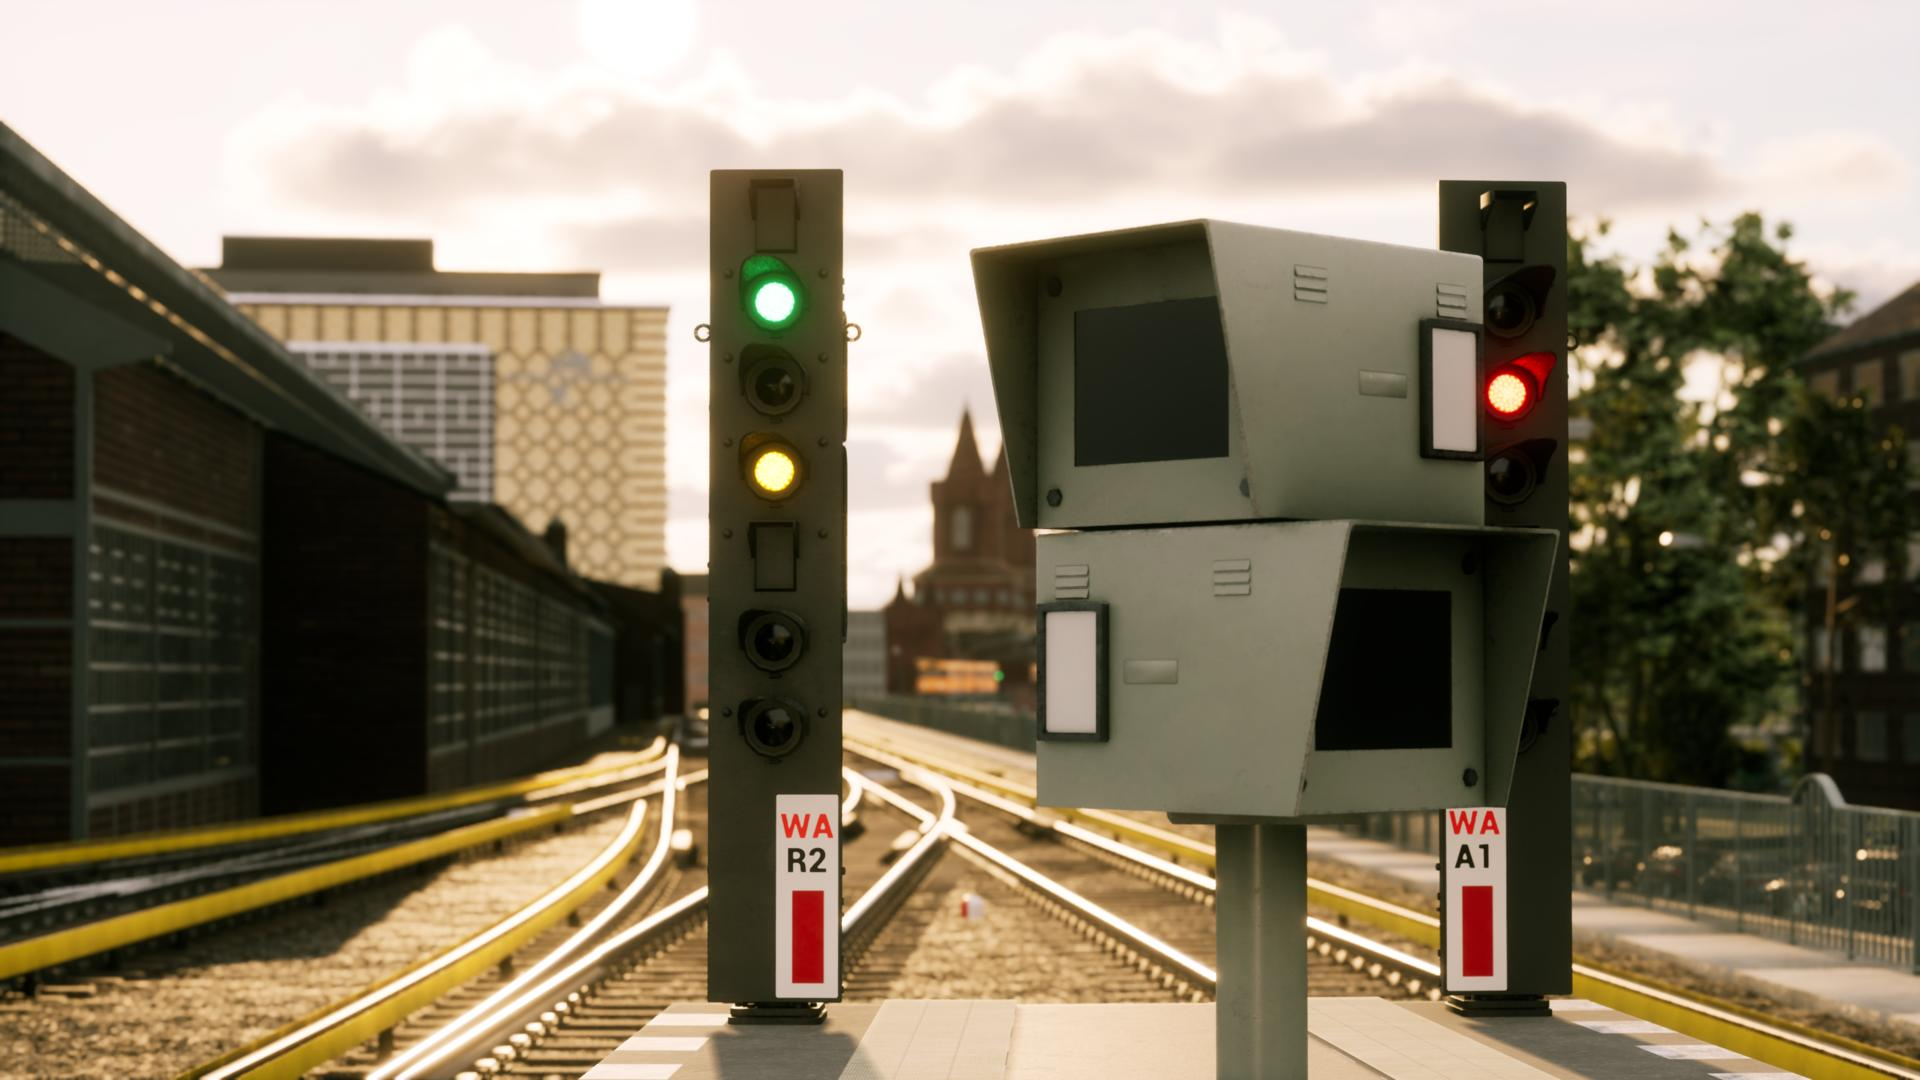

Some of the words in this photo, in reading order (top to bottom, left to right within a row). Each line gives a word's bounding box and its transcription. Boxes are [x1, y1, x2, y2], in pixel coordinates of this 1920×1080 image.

[781, 813, 833, 838] WA
[1449, 810, 1500, 835] WA
[788, 847, 827, 873] R2
[1455, 844, 1489, 868] A1
